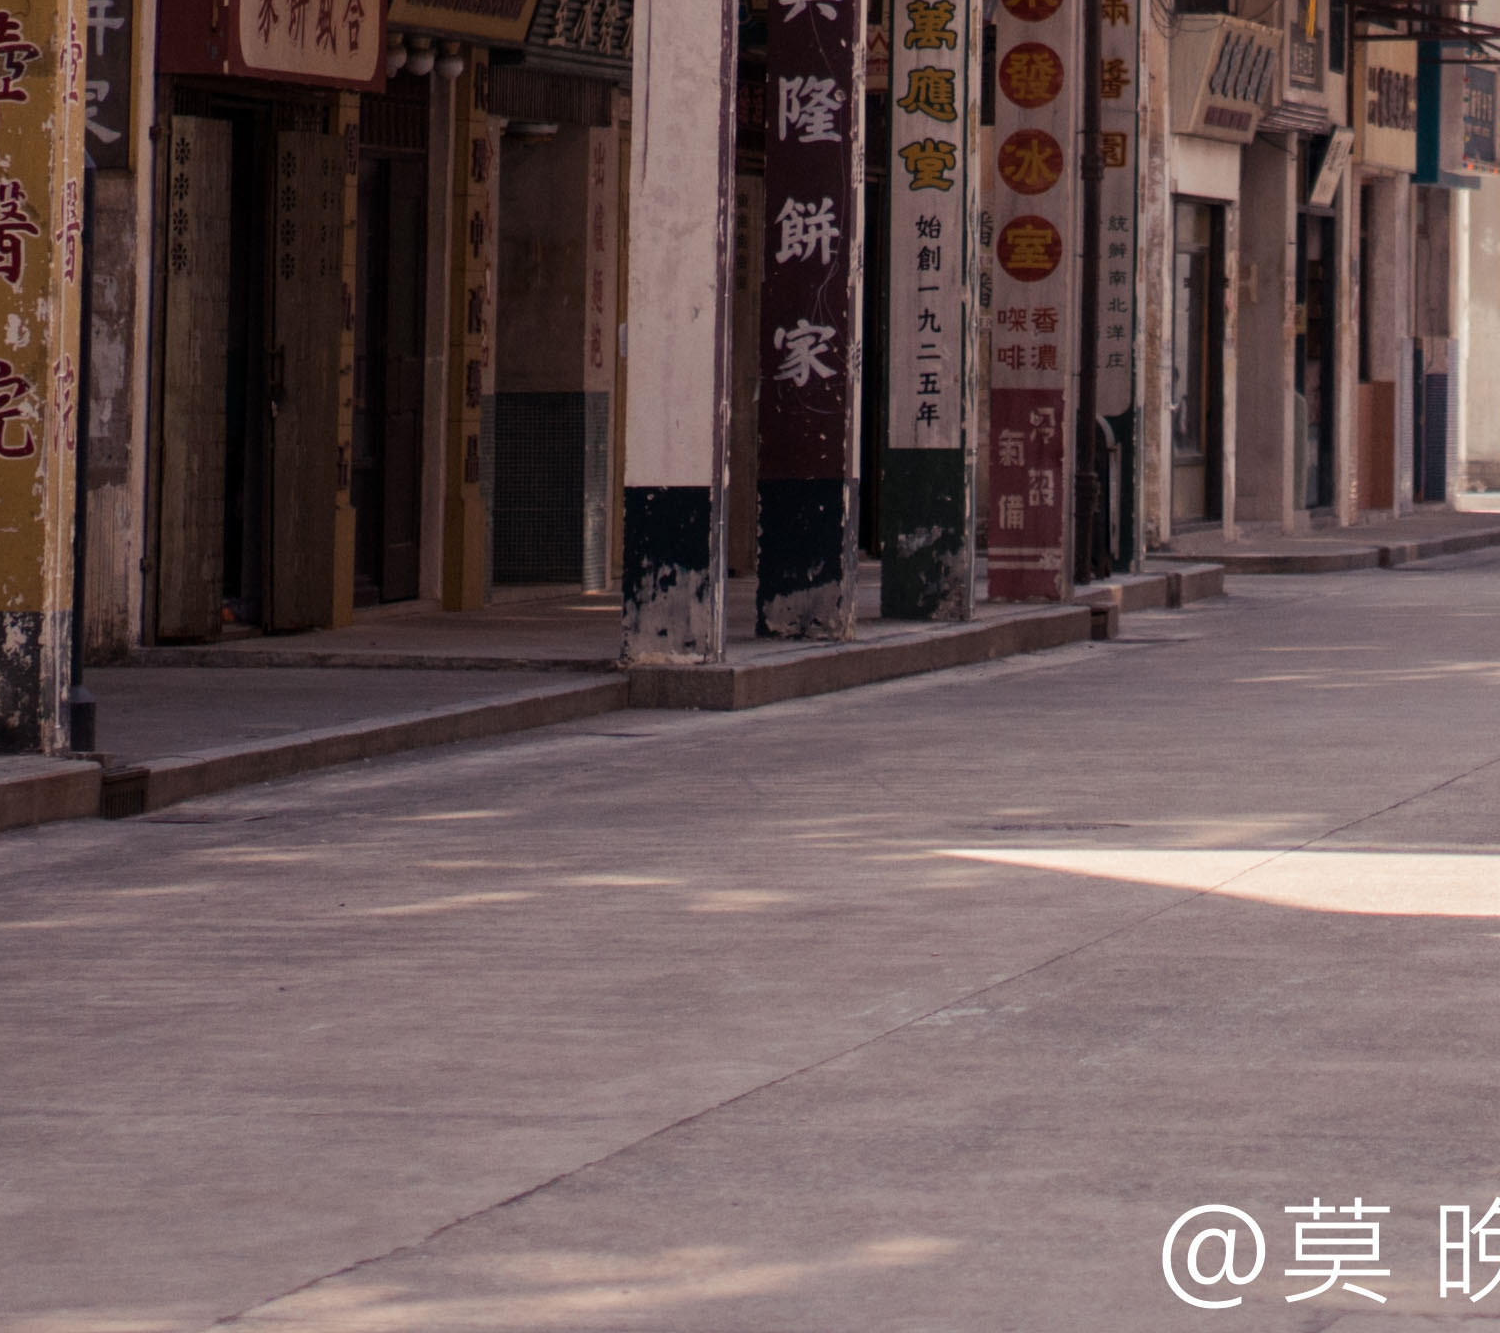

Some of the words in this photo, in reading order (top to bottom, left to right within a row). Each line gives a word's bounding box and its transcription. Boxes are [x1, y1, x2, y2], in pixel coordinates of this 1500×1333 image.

[914, 213, 943, 428] 始創一九二五年
[1030, 305, 1060, 372] 香濃
